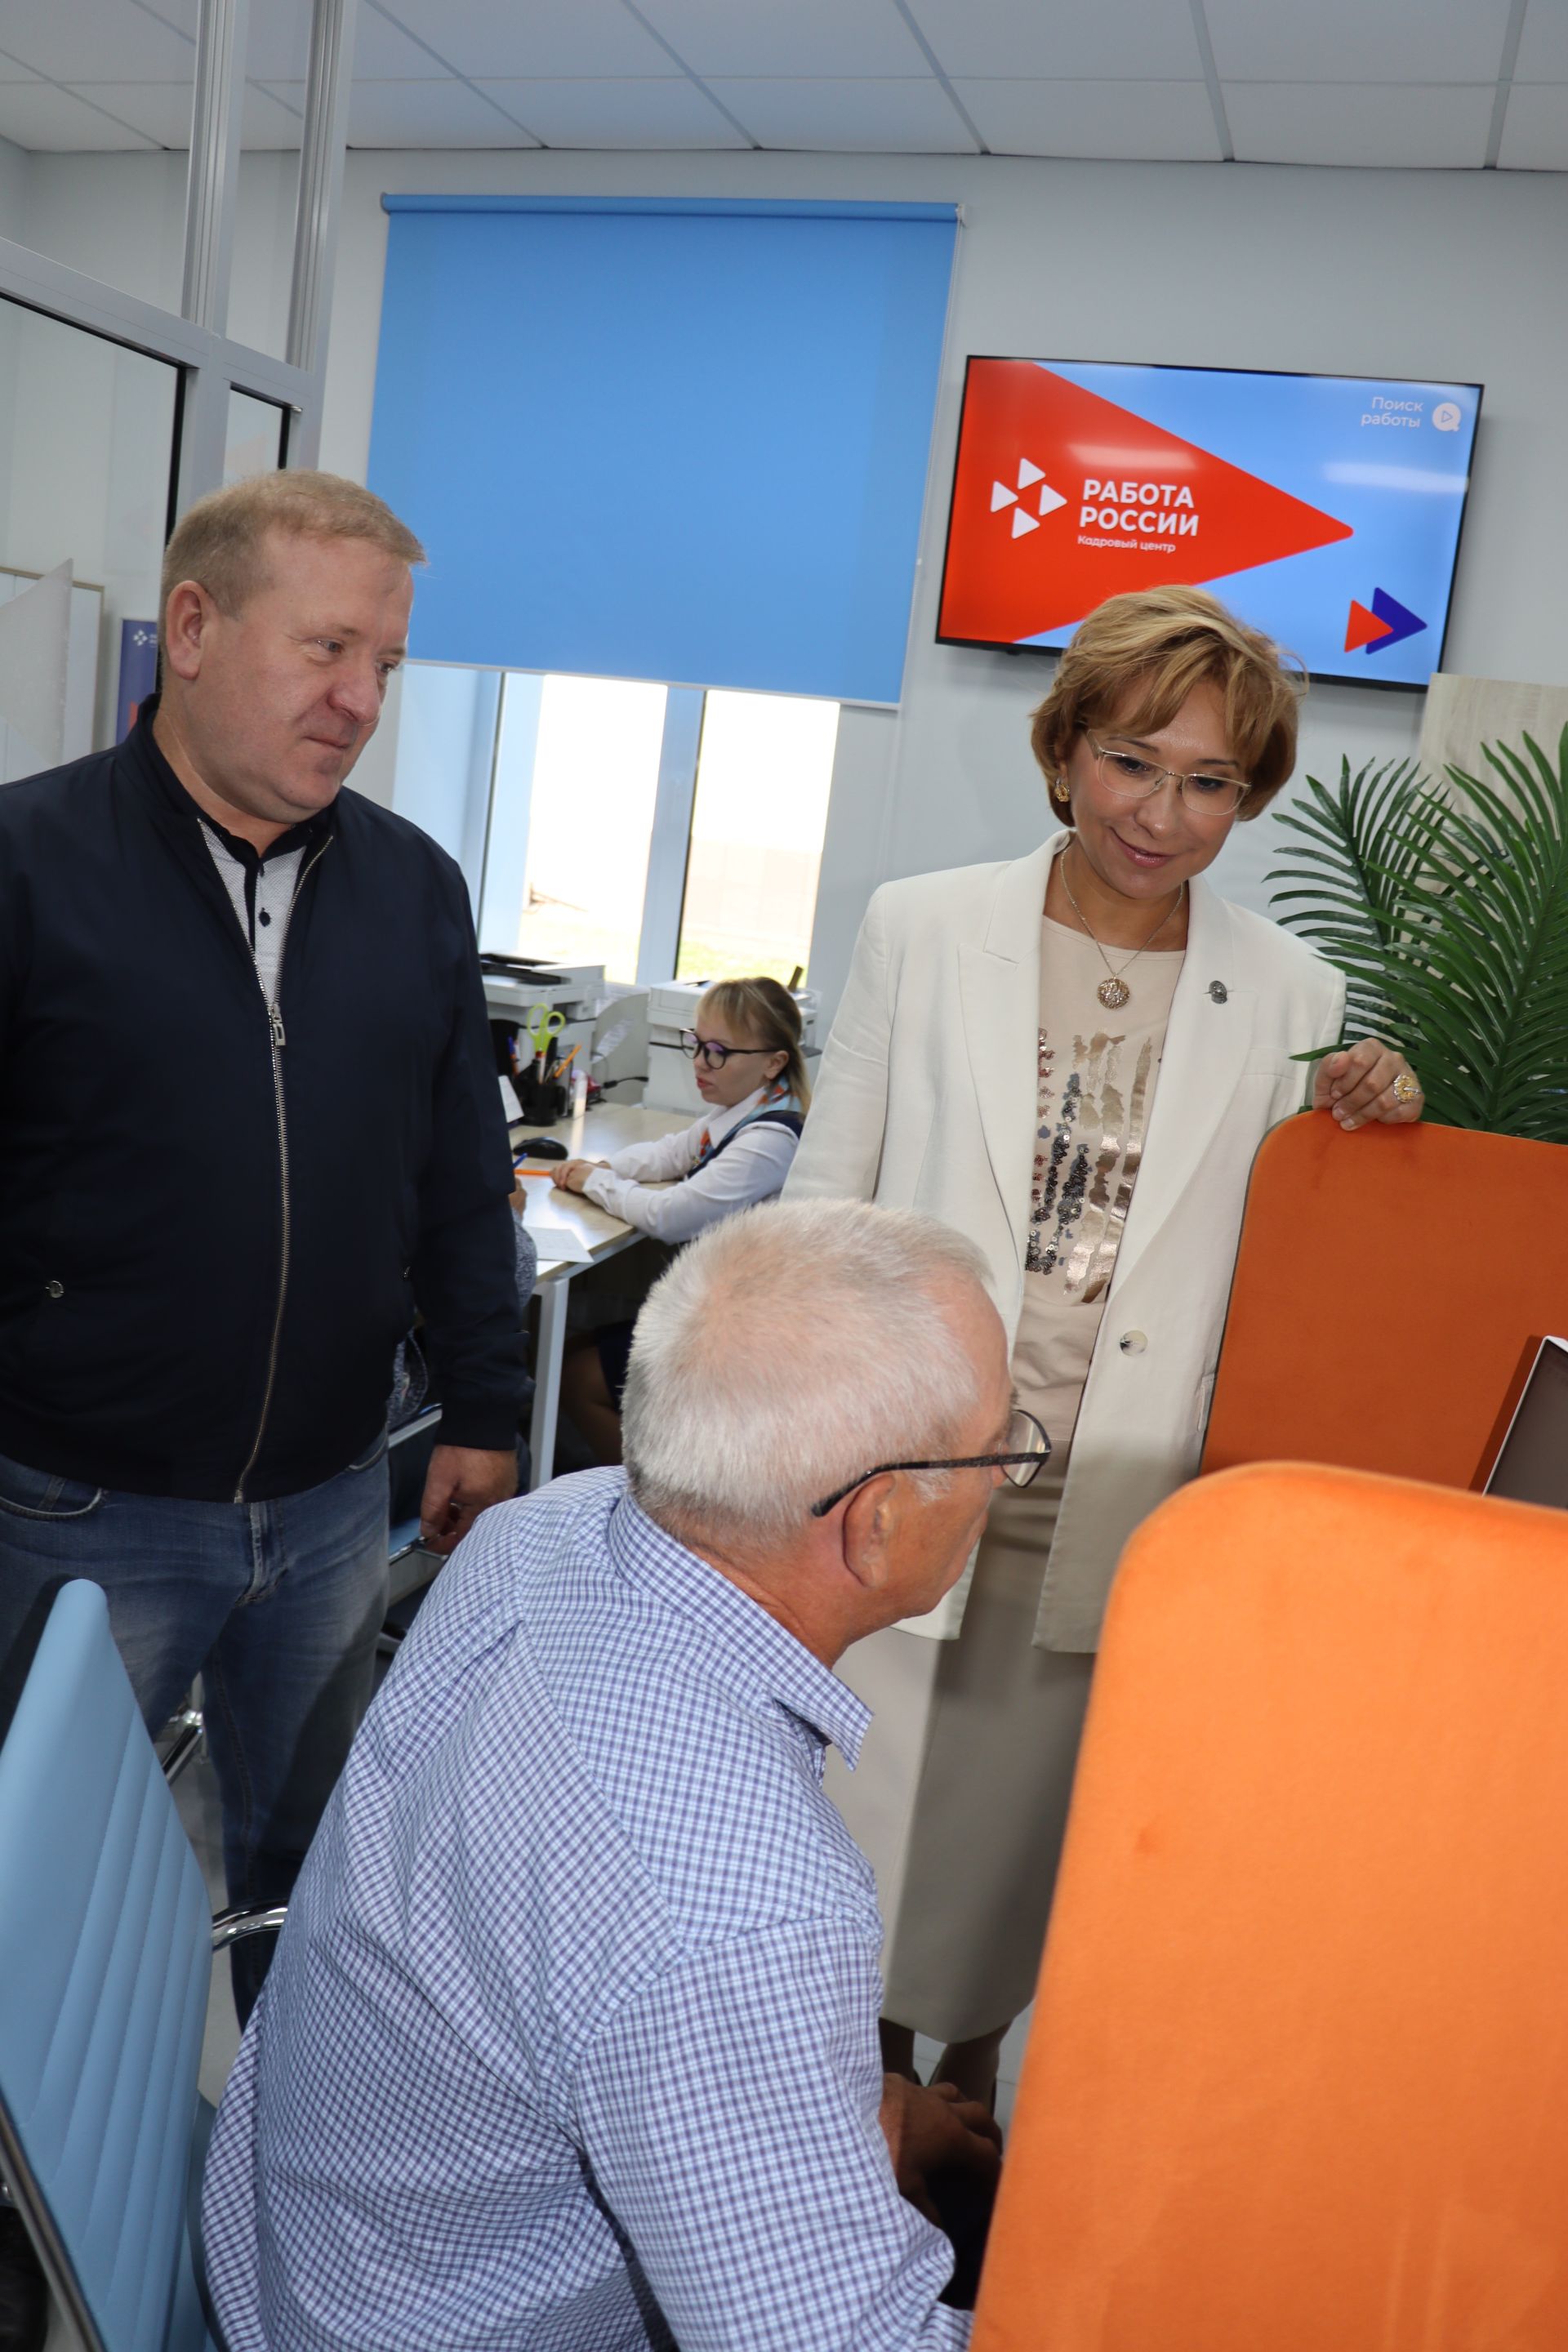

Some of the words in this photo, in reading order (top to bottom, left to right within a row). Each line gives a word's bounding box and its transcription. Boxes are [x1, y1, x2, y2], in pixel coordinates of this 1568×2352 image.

[1372, 397, 1424, 412] Поиск
[1361, 412, 1420, 428] работы
[1083, 479, 1195, 509] РАБОТА
[1079, 506, 1200, 537] РОССИИ
[1077, 535, 1138, 550] Кадровый
[1139, 541, 1176, 554] центр
